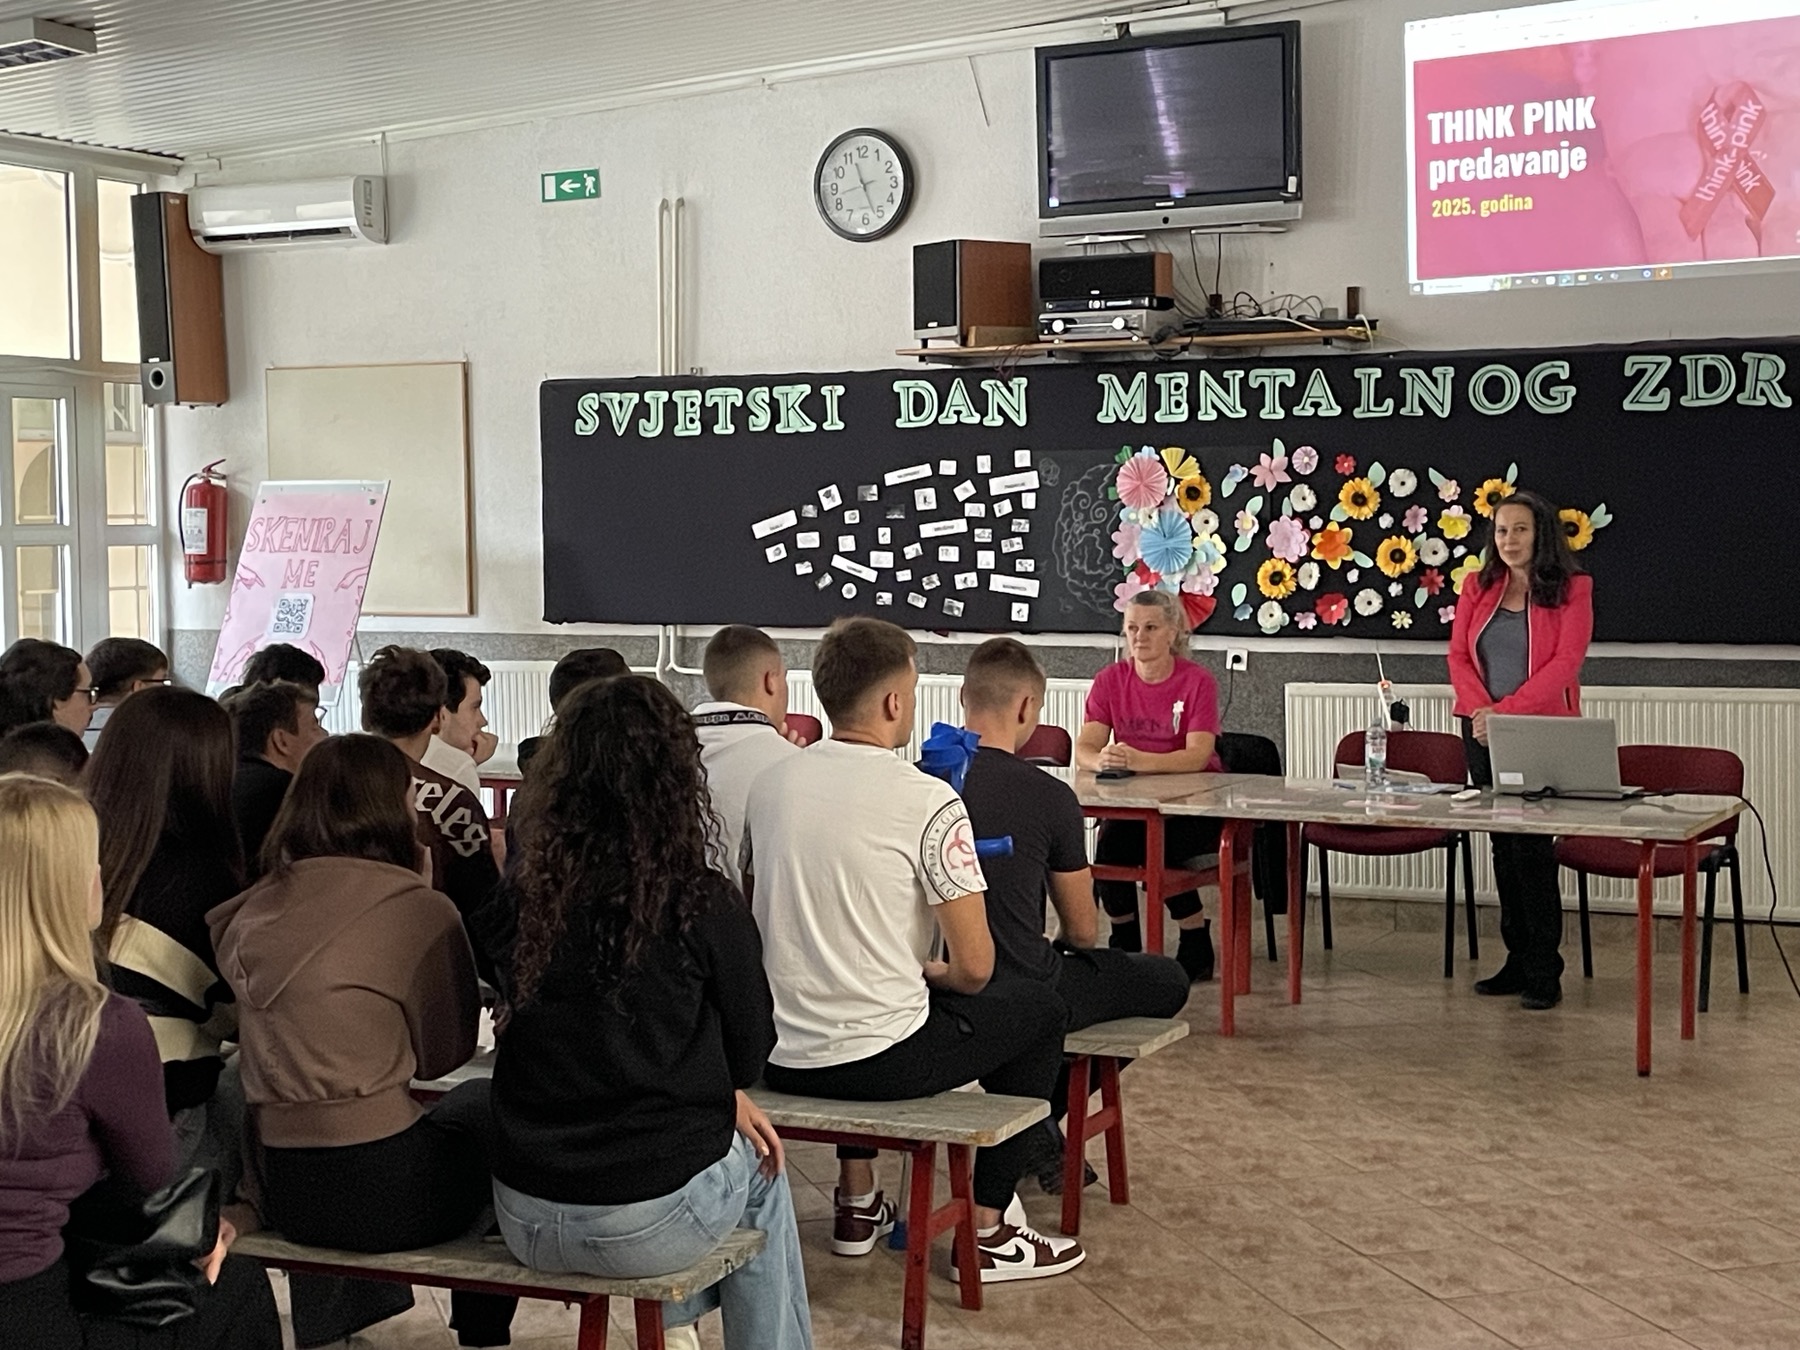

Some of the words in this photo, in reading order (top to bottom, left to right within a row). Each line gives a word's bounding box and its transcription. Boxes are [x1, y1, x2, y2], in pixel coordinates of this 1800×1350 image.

[1427, 105, 1515, 145] THINK
[1523, 96, 1596, 136] PINK
[856, 145, 869, 158] 12
[874, 149, 881, 161] 1
[843, 152, 853, 165] 11
[884, 161, 893, 173] 2
[1429, 140, 1587, 191] predavanje
[833, 166, 845, 179] 10
[889, 176, 899, 189] 3
[830, 183, 838, 196] 9
[835, 198, 843, 211] 8
[886, 192, 895, 205] 4
[876, 205, 885, 218] 5
[1431, 197, 1476, 218] 2025.
[1480, 194, 1533, 218] godina
[846, 209, 854, 221] 7
[861, 213, 870, 225] 6
[574, 384, 846, 438] SVJETSKI
[892, 377, 1028, 429] DAN
[1096, 360, 1577, 424] MENTALNOG
[1622, 352, 1793, 411] ZDR
[245, 516, 373, 555] SKENIRAJ
[281, 558, 319, 589] ME
